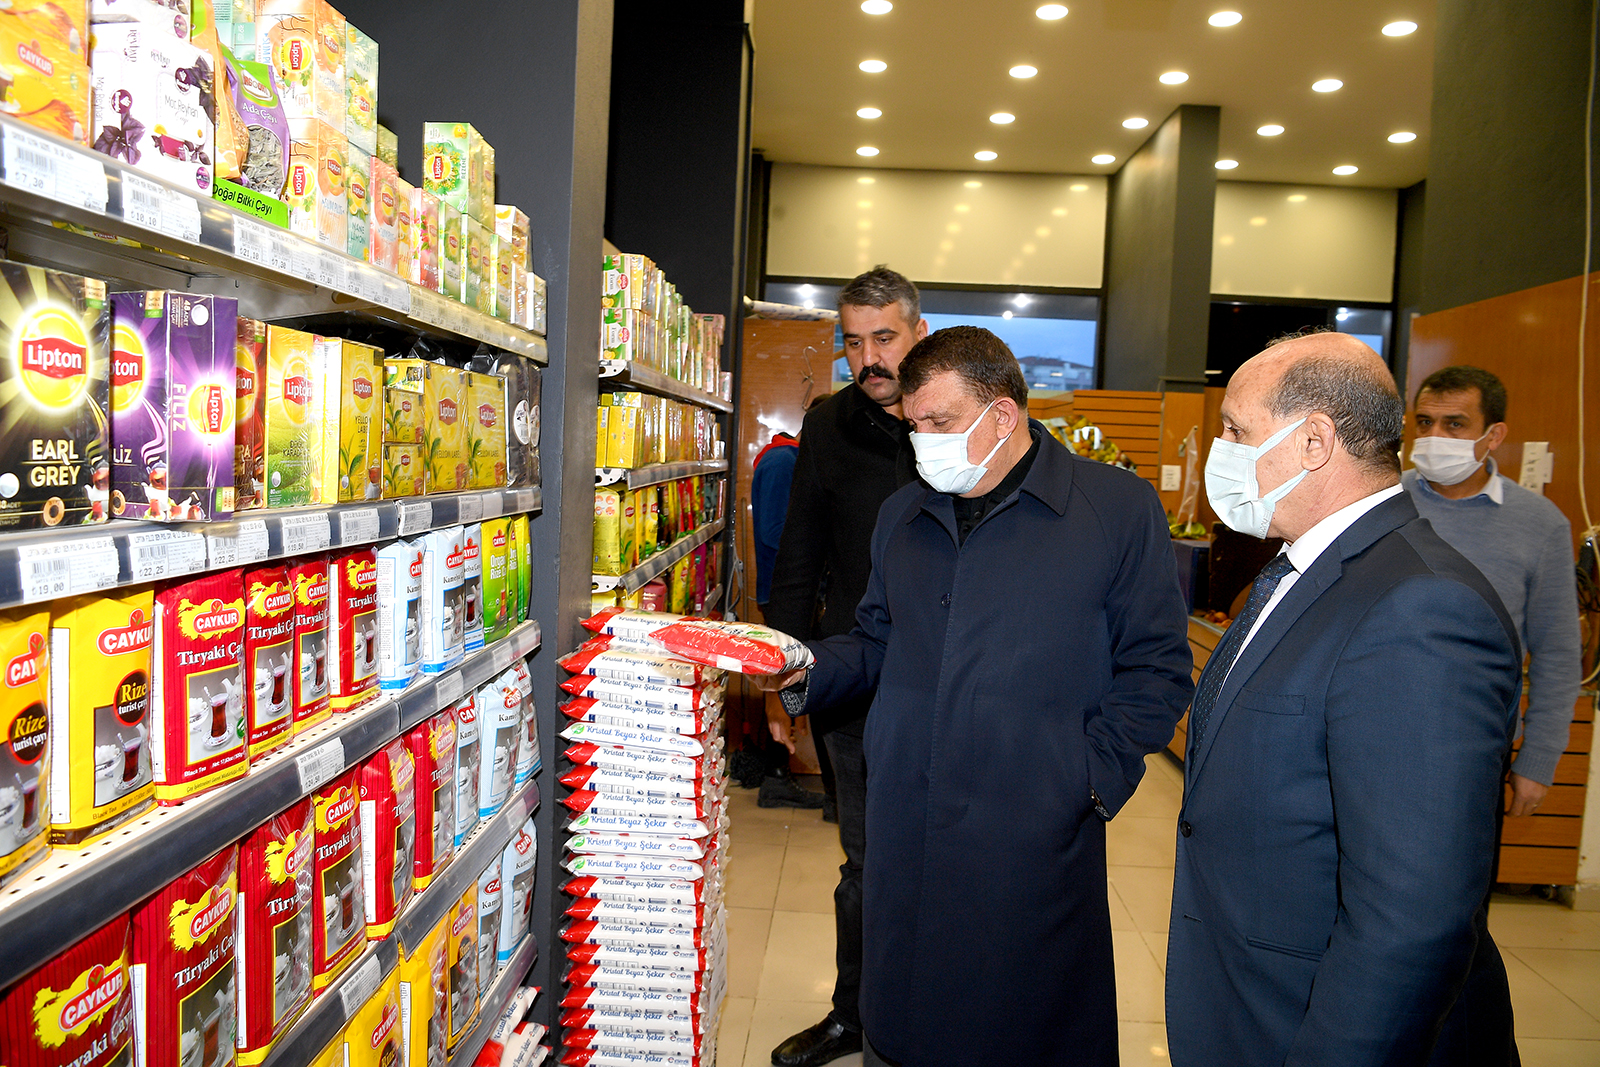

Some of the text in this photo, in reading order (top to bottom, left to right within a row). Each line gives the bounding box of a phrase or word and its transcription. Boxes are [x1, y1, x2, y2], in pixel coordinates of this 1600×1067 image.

[19, 46, 53, 74] ÇAYKUR
[291, 42, 300, 69] Lipton
[242, 102, 260, 116] Ada
[328, 160, 342, 175] Lipton
[294, 167, 303, 195] Lipton
[352, 183, 365, 199] Lipton
[213, 184, 273, 216] Doğal Bitki Çayı
[27, 345, 82, 370] Lipton
[110, 361, 139, 377] pton
[286, 381, 312, 399] Lipton
[353, 382, 372, 395] Lipton
[210, 389, 220, 429] Lipton
[440, 403, 457, 419] Lipton
[480, 408, 495, 422] Lipton
[32, 439, 79, 465] EARL
[112, 447, 133, 464] LİZ
[30, 465, 80, 487] GREY
[490, 565, 501, 579] Rize
[266, 593, 291, 610] ÇAYKUR
[347, 595, 373, 609] Tiryaki
[197, 613, 238, 632] ÇAYKUR
[295, 611, 324, 627] Tiryaki
[618, 615, 657, 627] Kristal Beyaz
[103, 624, 152, 652] ÇAYKU
[248, 622, 285, 640] Tiryaki
[618, 636, 638, 645] Kristal
[177, 644, 226, 667] Tiryaki
[601, 655, 665, 669] Kristal Beyaz Şeker
[120, 681, 148, 704] Rize
[600, 677, 663, 692] Kristal Beyaz Şeker
[118, 701, 138, 715] turist
[601, 701, 665, 716] Kristal Beyaz Şeker
[14, 714, 47, 737] Rize
[586, 725, 664, 743] Kristal Beyaz Şeker
[13, 734, 32, 753] turist
[603, 748, 666, 764] Kristal Beyaz Şeker
[183, 768, 199, 777] Black
[601, 769, 665, 782] Kristal Beyaz Şeker
[602, 793, 666, 806] Kristal Beyaz Şeker
[328, 796, 355, 823] ÇAYKUR
[590, 815, 667, 829] Kristal Beyaz Şeker
[316, 833, 351, 861] Tiryaki
[586, 837, 663, 851] Kristal Beyaz Şeker
[586, 858, 663, 872] Kristal Beyaz Şeker
[602, 878, 665, 890] Kristal Beyaz Şeker
[193, 894, 230, 936] ÇAYKUR
[603, 901, 666, 914] Kristal Beyaz Şeker
[453, 908, 475, 937] ÇAYKUR
[601, 923, 664, 935] Kristal Beyaz Şeker
[605, 945, 669, 957] Kristal Beyaz Şeker
[173, 945, 219, 990] Tiryaki
[602, 967, 665, 979] Kristal Beyaz Şeker
[64, 972, 123, 1028] ÇAYKUR
[599, 989, 661, 1001] Kristal Beyaz Şeker
[623, 1012, 642, 1020] Beyaz
[644, 1013, 662, 1021] Şeker
[373, 1008, 398, 1046] ÇAYKUR
[603, 1030, 665, 1042] Kristal Beyaz Şeker
[601, 1051, 663, 1063] Kristal Beyaz Şeker
